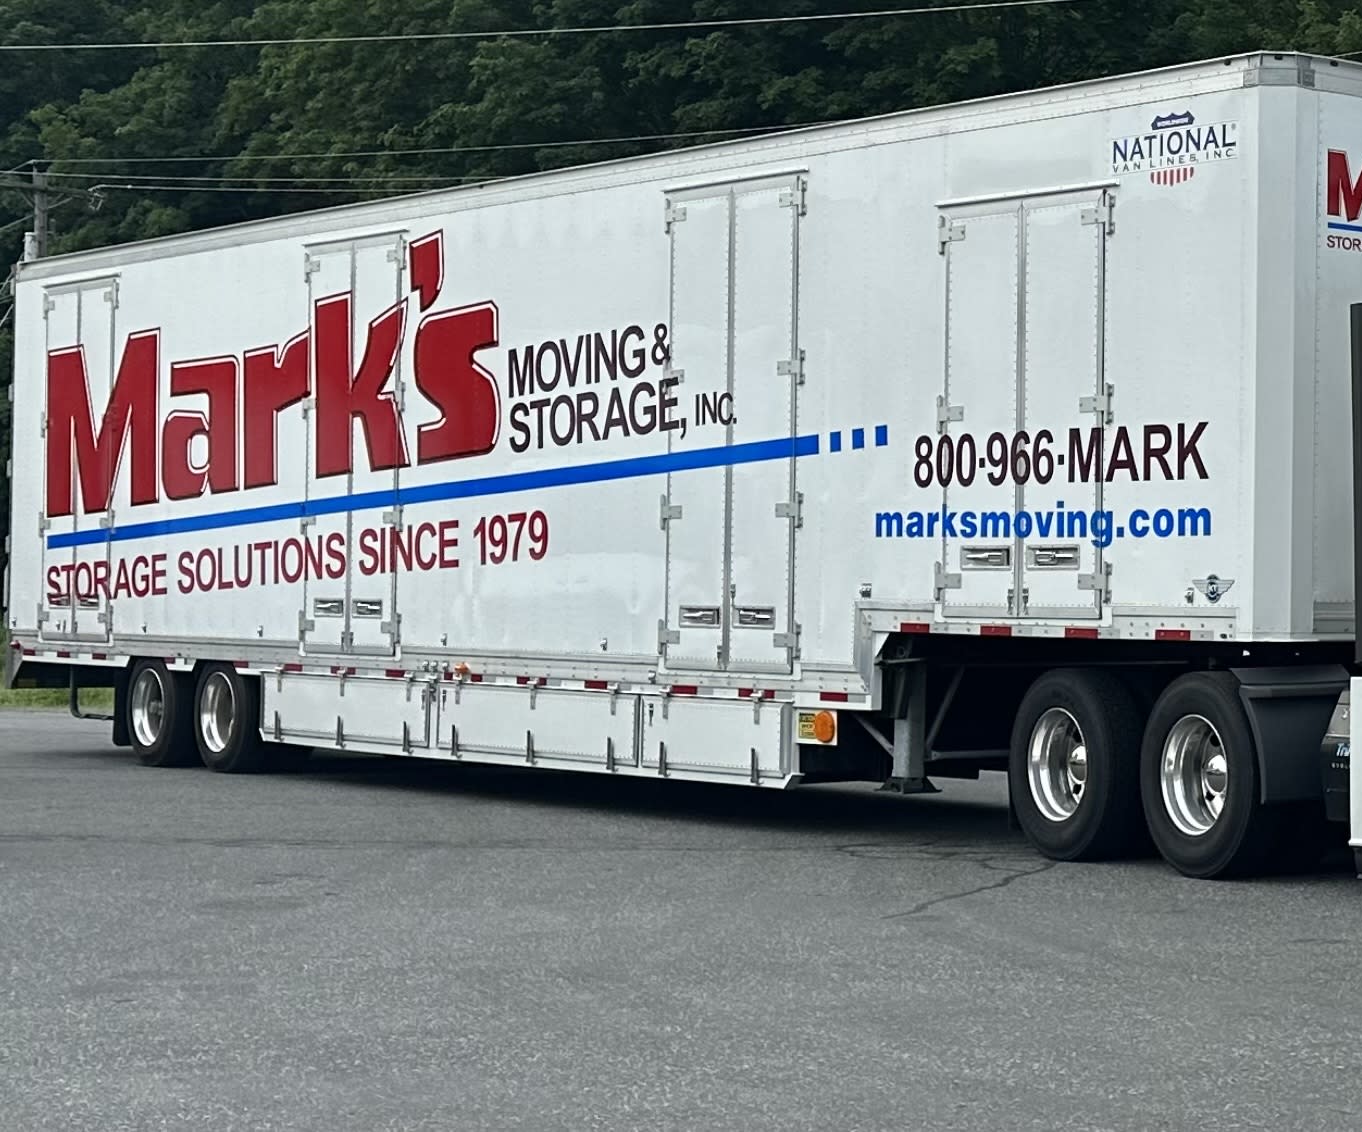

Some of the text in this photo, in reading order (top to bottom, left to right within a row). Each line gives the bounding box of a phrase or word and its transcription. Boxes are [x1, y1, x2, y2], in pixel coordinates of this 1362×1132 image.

[1112, 161, 1141, 173] VAN
[1113, 124, 1236, 164] NATIONAL
[47, 229, 498, 518] Mark's
[508, 323, 670, 398] MOVING &
[509, 376, 737, 453] STORAGE, INC.
[47, 510, 548, 605] STORAGE SOLUTIONS SINCE 1979
[875, 501, 1211, 547] marksmoving.com
